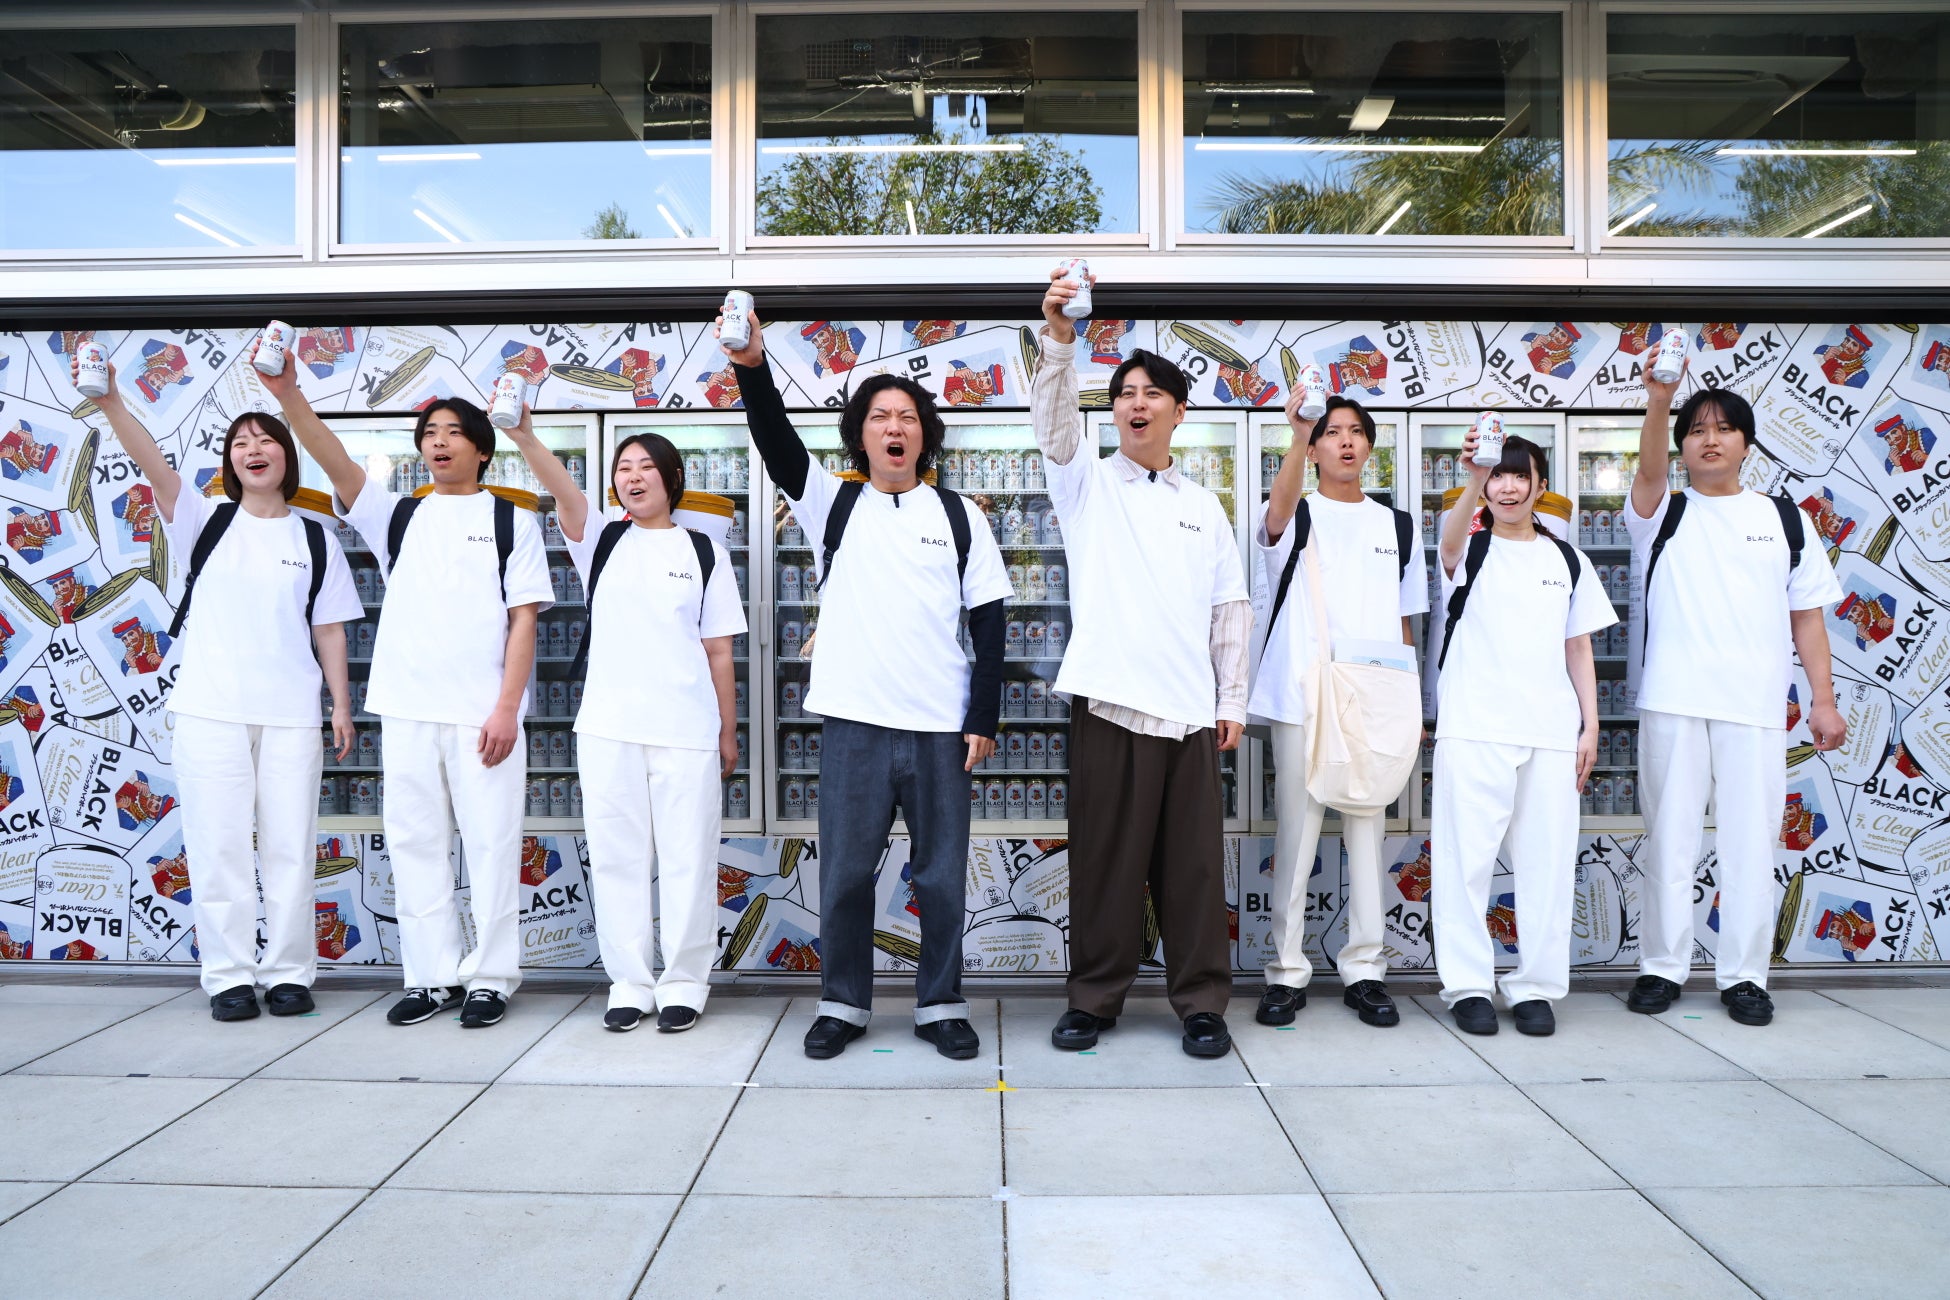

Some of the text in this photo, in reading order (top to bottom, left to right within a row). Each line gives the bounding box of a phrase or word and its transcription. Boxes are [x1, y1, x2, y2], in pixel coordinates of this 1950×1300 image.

[170, 329, 227, 371] BLA
[1661, 348, 1685, 358] BLACK
[1701, 330, 1781, 391] BLACK
[81, 363, 107, 373] BLACK
[1487, 348, 1564, 407] BLACK
[1782, 362, 1860, 428] BLACK
[1784, 386, 1840, 430] ブラックニッカハイボール
[1778, 406, 1825, 442] Clear
[468, 535, 495, 543] BLACK
[920, 536, 948, 547] BLACK
[1179, 521, 1202, 533] BLACK
[281, 559, 308, 570] BLACK
[1375, 547, 1399, 556] BLACK
[1875, 600, 1935, 682] BLACK
[1898, 620, 1938, 680] ブラックニッカハイボール
[1917, 635, 1949, 684] Clear
[58, 754, 83, 806] Clear
[82, 747, 121, 832] BLACK
[1863, 776, 1947, 811] BLACK
[1869, 798, 1935, 819] ブラックニッカハイボール
[57, 882, 107, 901] Clear
[1246, 893, 1334, 913] BLCK
[40, 912, 122, 938] BLACK
[1572, 887, 1587, 940] Clear
[524, 927, 574, 948] Clear
